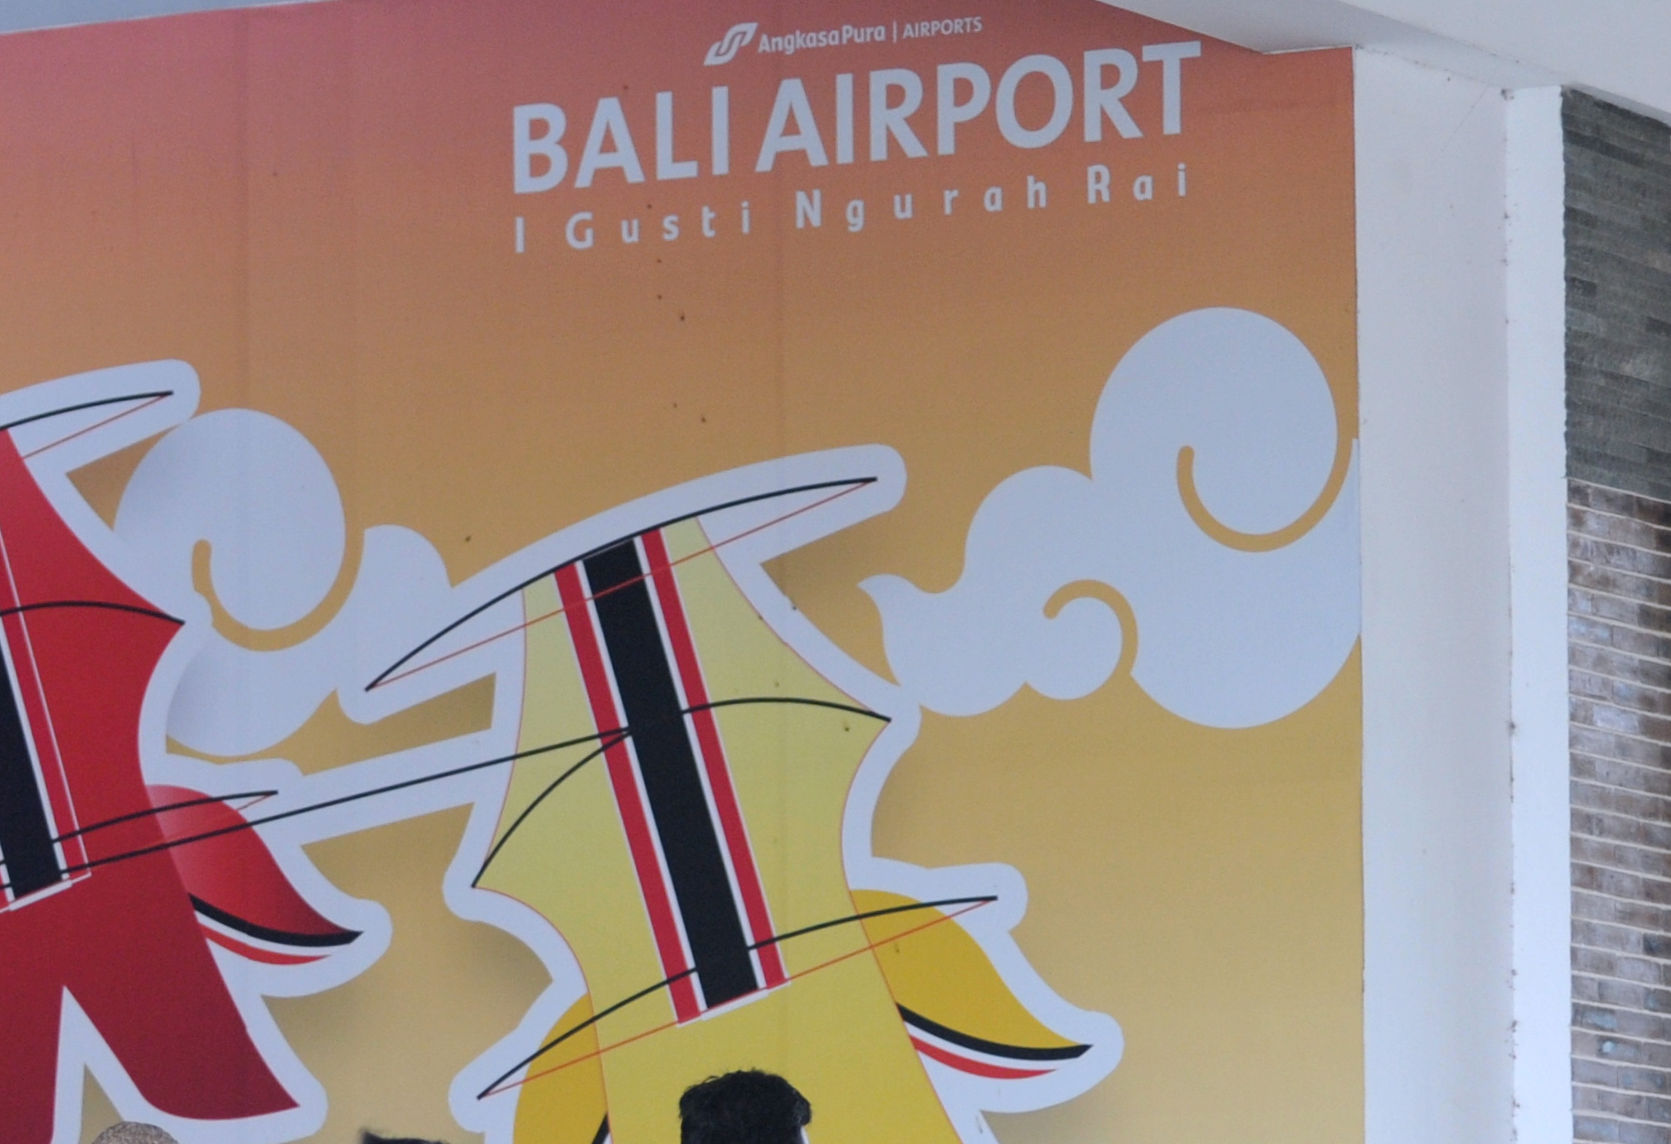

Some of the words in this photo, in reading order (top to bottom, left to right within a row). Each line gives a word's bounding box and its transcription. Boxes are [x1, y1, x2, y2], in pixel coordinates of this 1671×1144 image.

[903, 16, 983, 39] AIRPORTS
[513, 85, 730, 195] BALI
[755, 40, 1201, 172] AIRPORT
[515, 217, 526, 253] I
[565, 201, 751, 249] Gusti
[795, 175, 1047, 231] Ngurah
[1087, 162, 1187, 204] Rai
